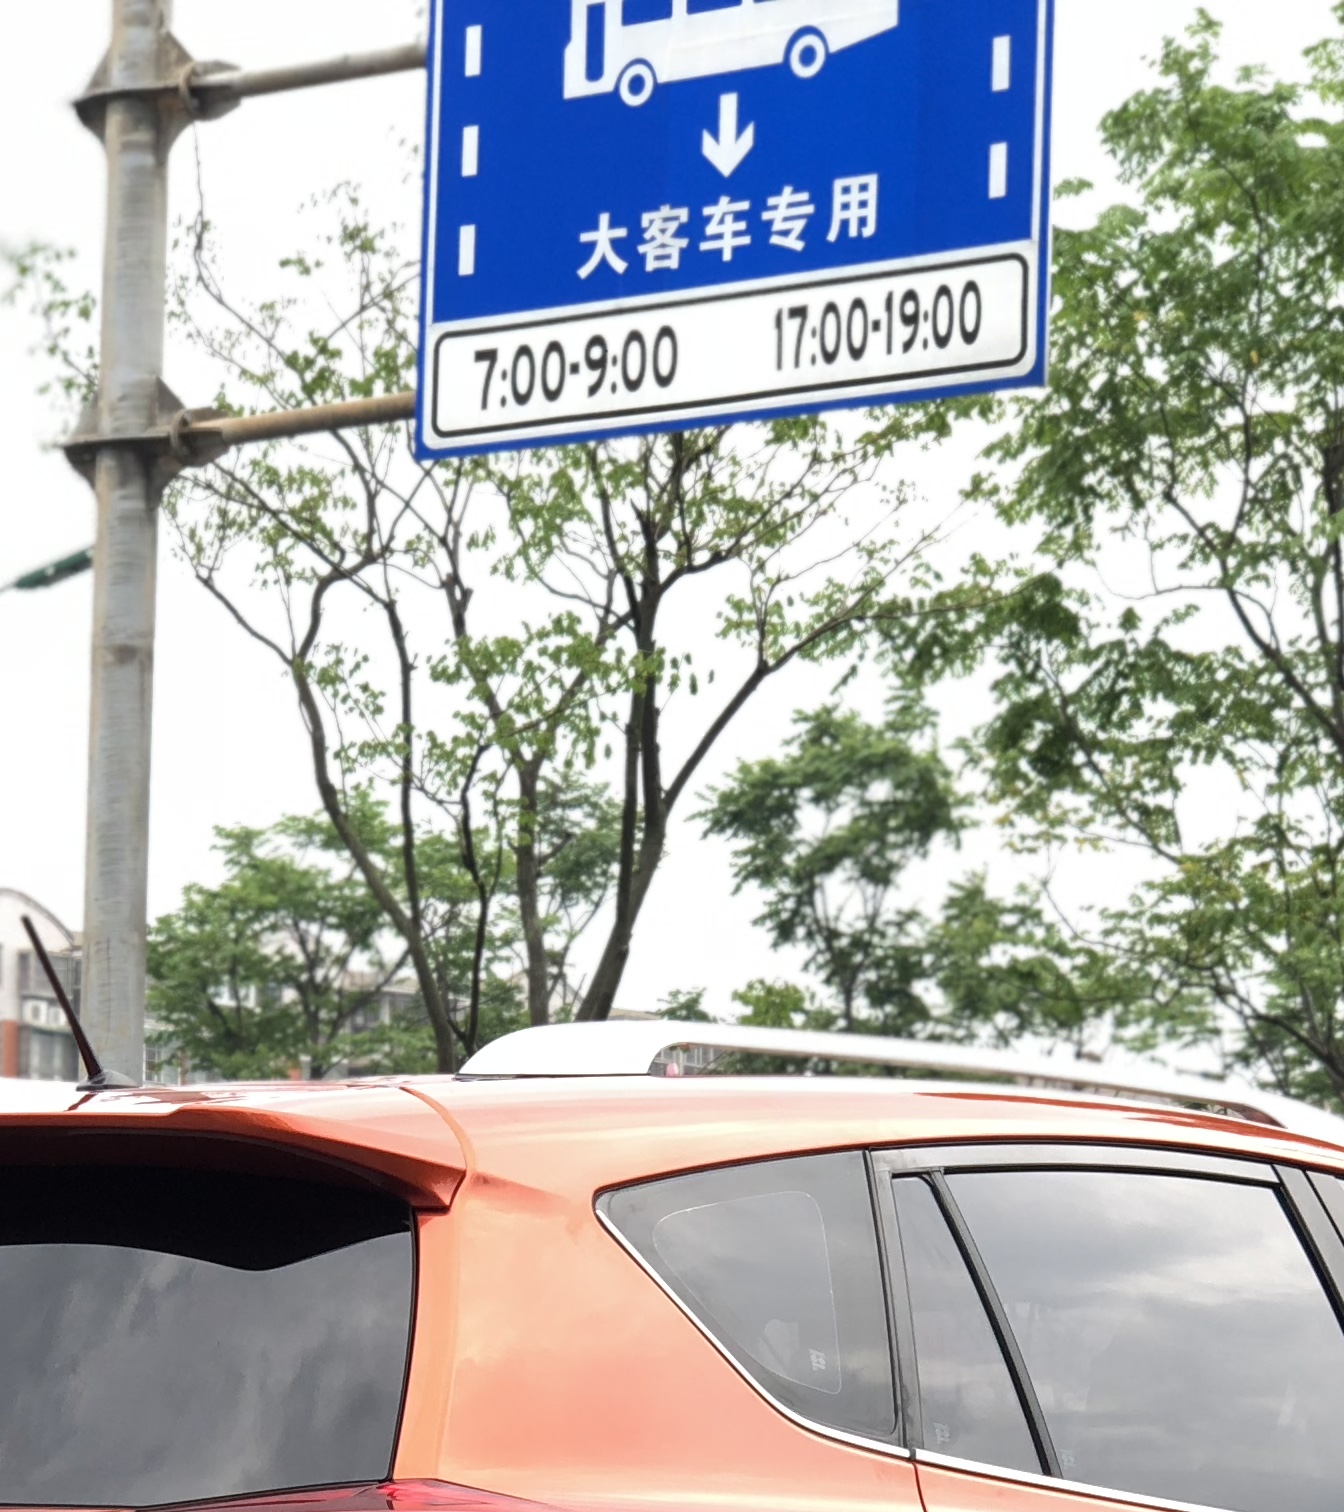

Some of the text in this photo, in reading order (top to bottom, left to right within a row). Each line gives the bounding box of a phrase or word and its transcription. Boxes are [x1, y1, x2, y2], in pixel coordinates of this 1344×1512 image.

[576, 173, 878, 280] 大客车专用
[474, 279, 982, 411] 7:00-9:00 17:00-19:00
